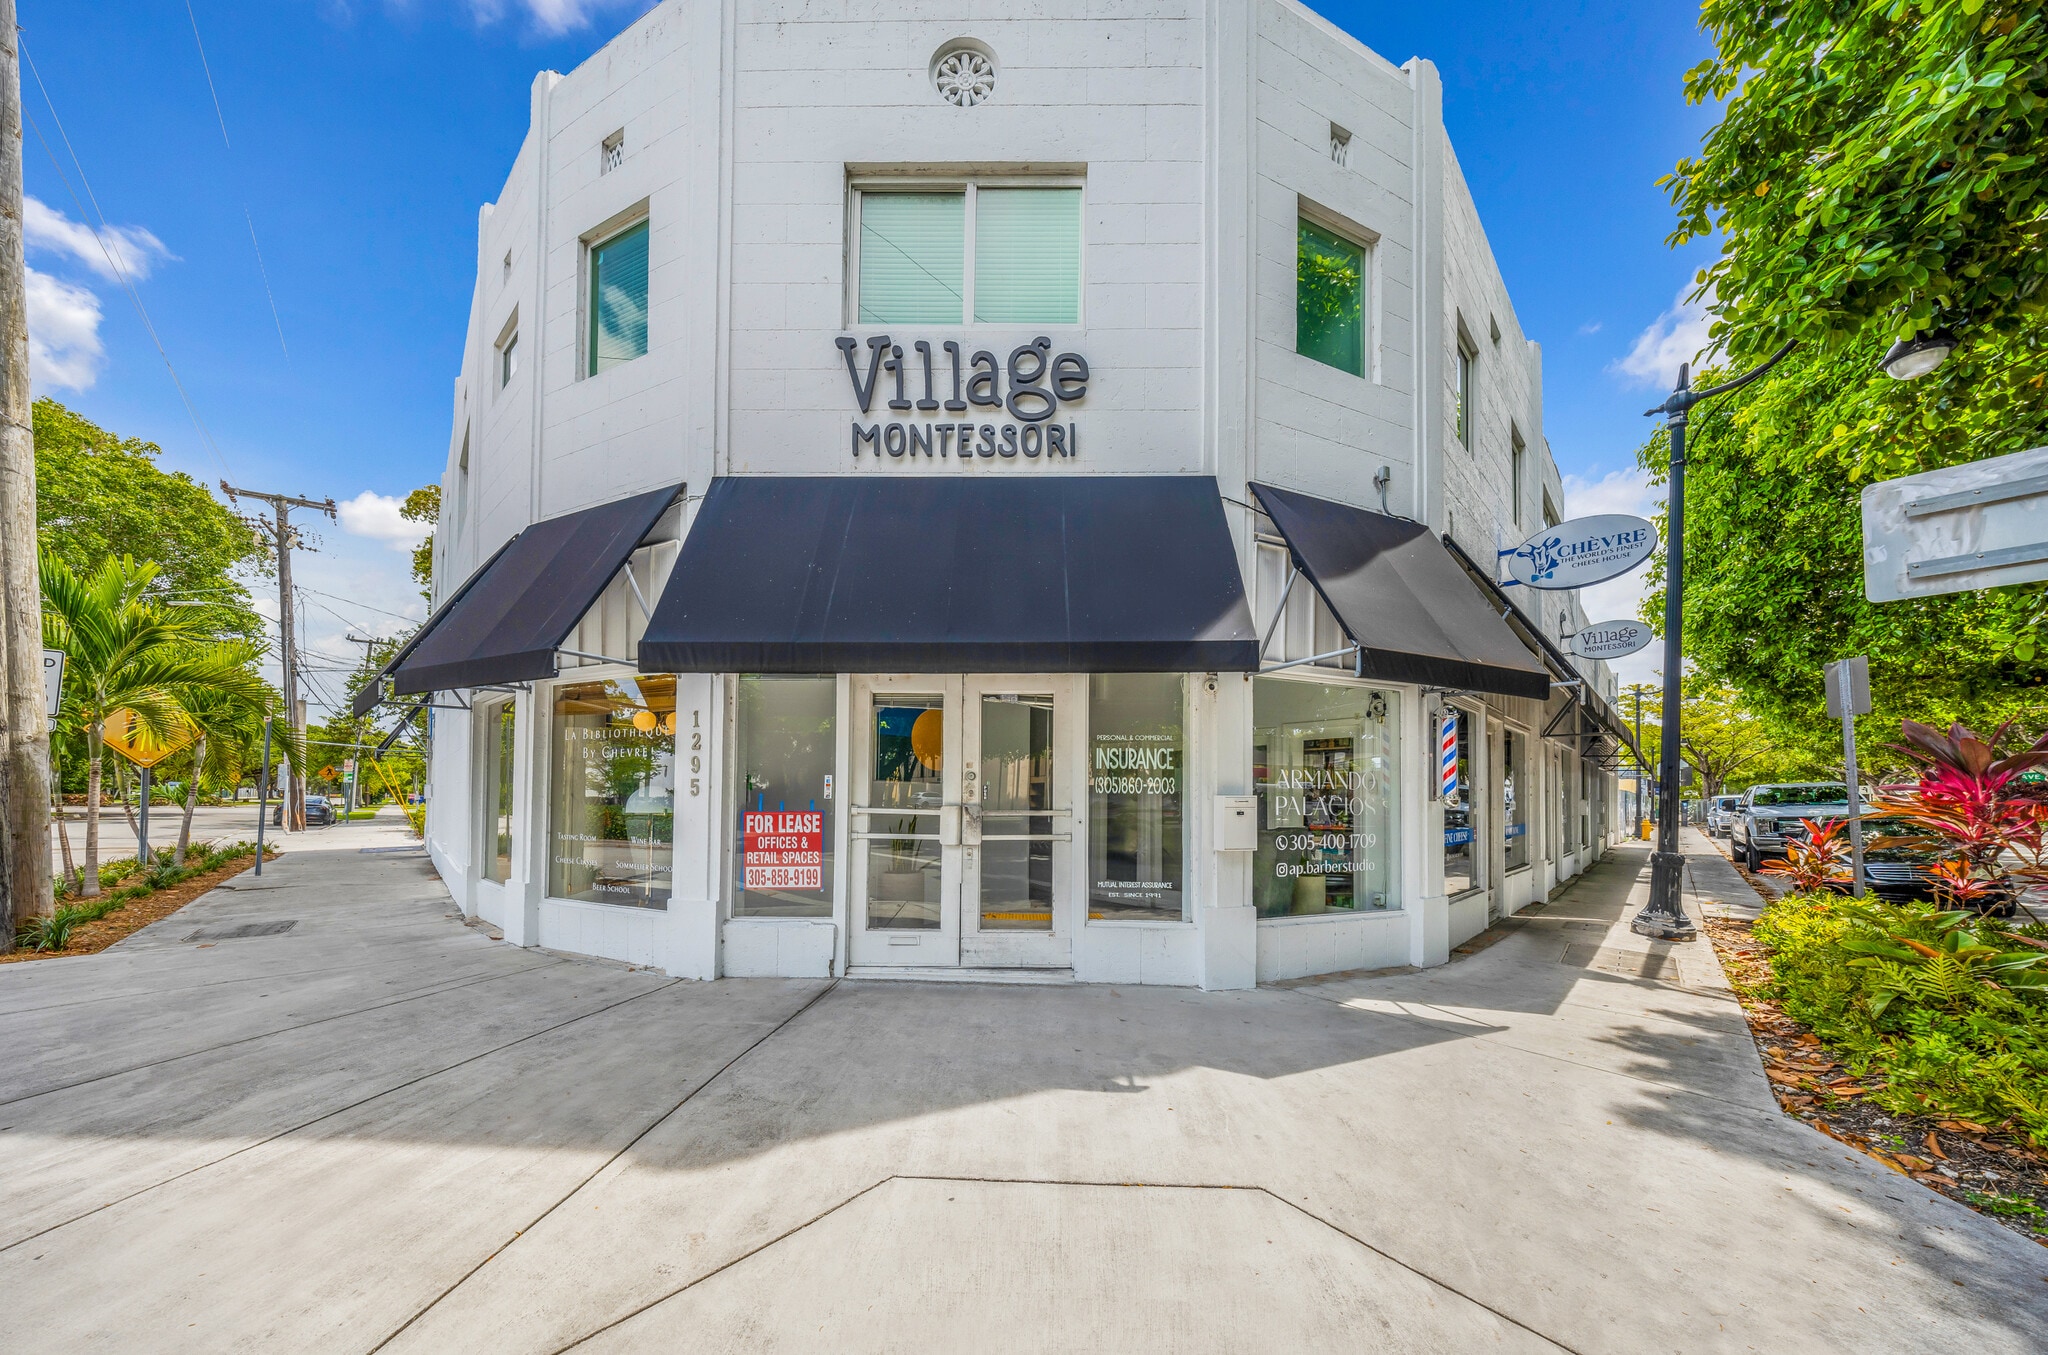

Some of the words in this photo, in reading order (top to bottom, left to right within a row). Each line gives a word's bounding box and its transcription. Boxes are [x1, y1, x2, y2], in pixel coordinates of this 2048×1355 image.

[834, 335, 1090, 422] Village
[852, 422, 1076, 458] MONTESSORI
[1557, 528, 1648, 558] CHÈVRE
[1560, 556, 1575, 564] THE
[1576, 547, 1615, 560] WORLD'S
[1616, 541, 1645, 553] FINEST
[1571, 558, 1600, 569] CHEESE
[1602, 551, 1632, 562] HOUSE
[1580, 626, 1639, 646] Village
[1584, 640, 1637, 653] MONTESSORI
[1096, 747, 1175, 770] INSURANCE
[1094, 776, 1176, 795] (305)860-2003
[1276, 769, 1377, 791] ARMANDO
[2021, 773, 2042, 781] AVE
[1275, 795, 1377, 817] PALACIOS
[746, 814, 774, 834] FOR
[778, 814, 820, 834] LEASE
[757, 836, 798, 849] OFFICES
[800, 836, 809, 849] &
[1289, 833, 1377, 850] 305-400-1709
[746, 851, 780, 864] RETAIL
[782, 851, 820, 864] SPACES
[748, 868, 819, 886] 305-858-9199
[1288, 858, 1376, 878] ap.barberstudio
[1141, 881, 1173, 889] ASSURANCE
